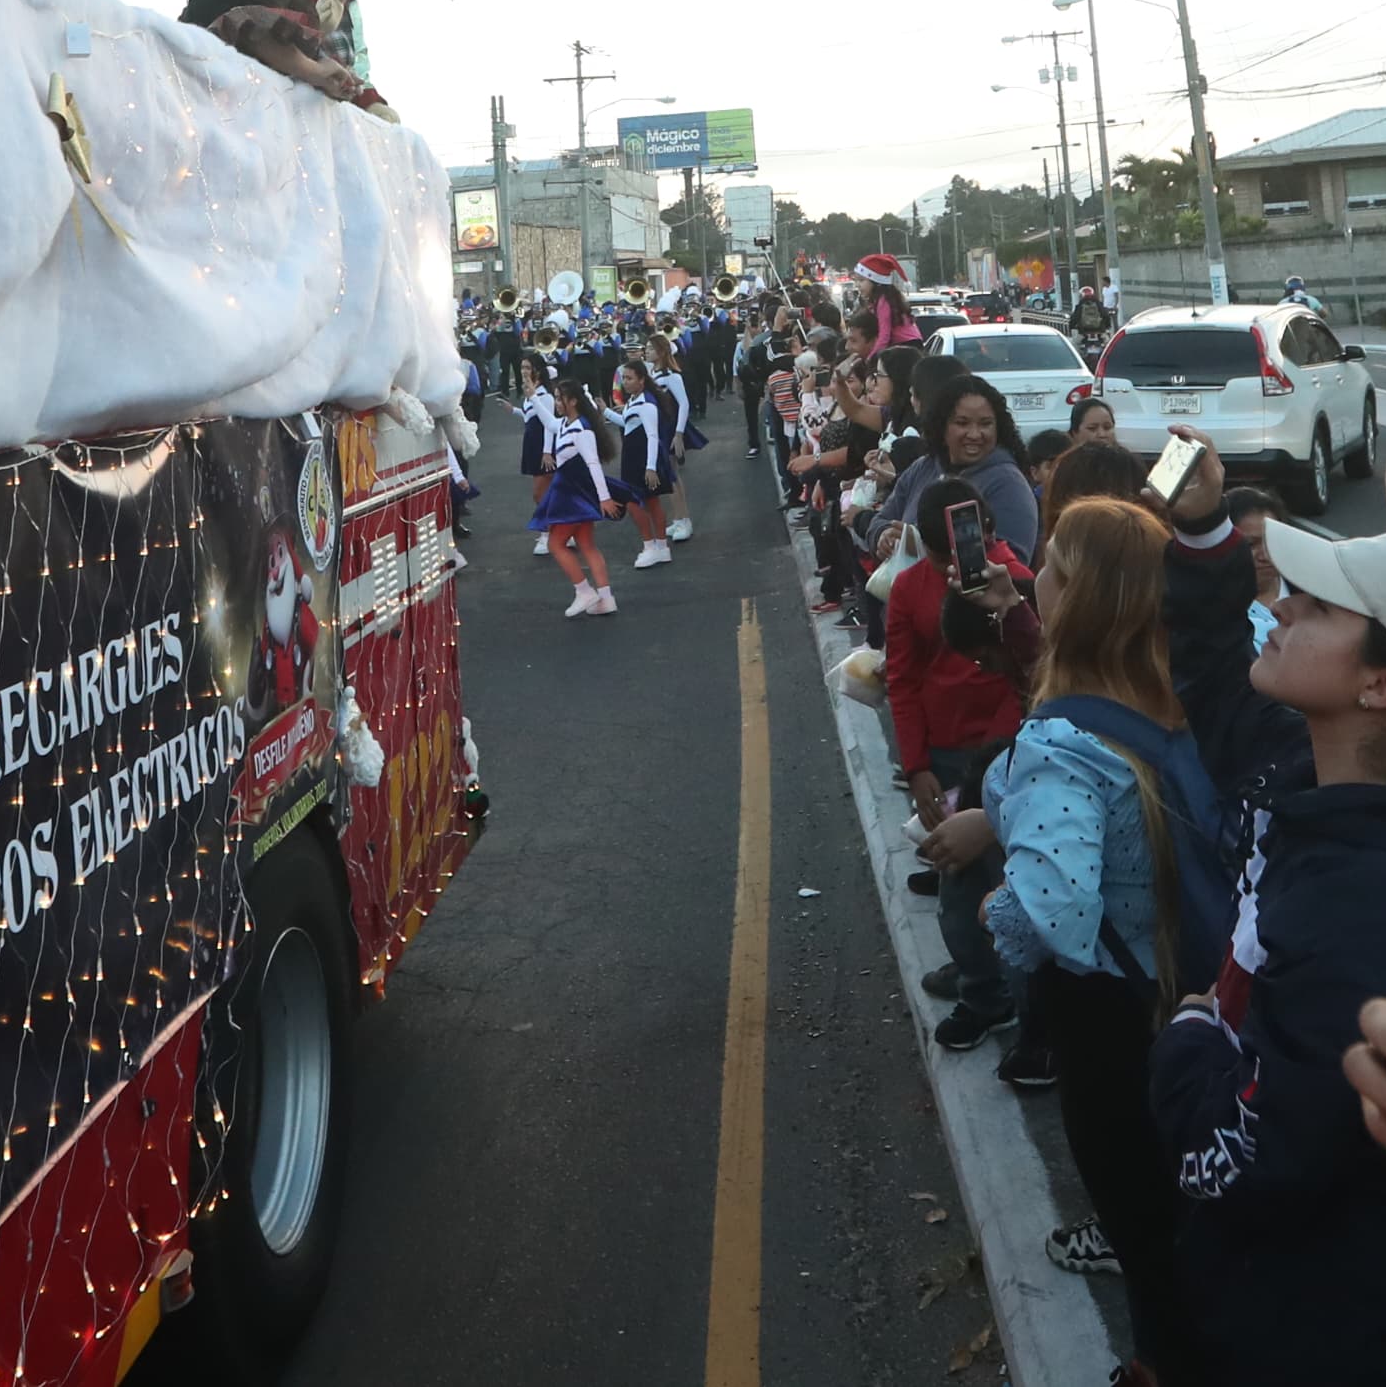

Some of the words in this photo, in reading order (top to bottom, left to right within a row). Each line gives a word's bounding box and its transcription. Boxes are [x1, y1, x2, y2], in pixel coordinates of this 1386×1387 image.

[646, 141, 702, 155] diciembre
[69, 694, 246, 879] ELECTRICOS
[253, 734, 287, 780] DESFILE
[252, 821, 284, 863] BOMBEROS
[281, 788, 317, 839] VOLUNTARIOS
